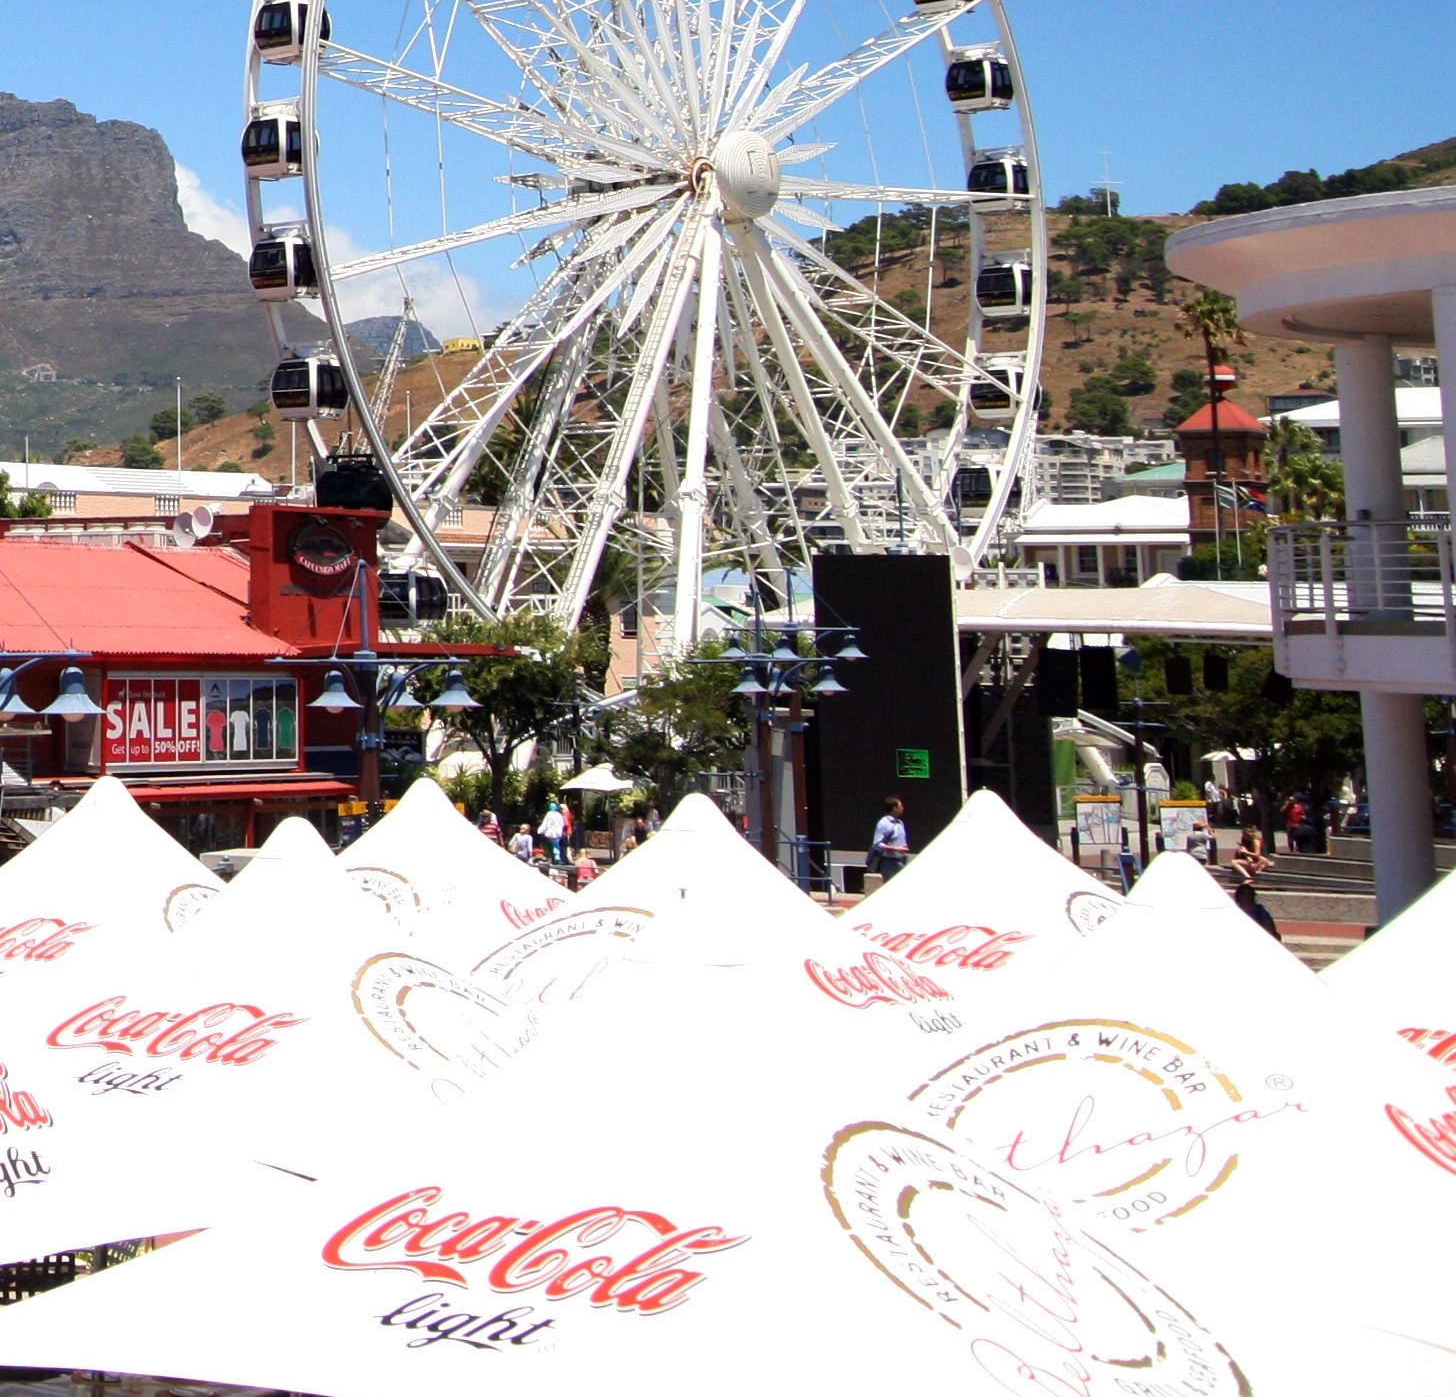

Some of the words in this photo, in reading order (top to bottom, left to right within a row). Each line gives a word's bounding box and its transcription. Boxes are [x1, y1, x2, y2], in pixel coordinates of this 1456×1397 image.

[106, 701, 197, 739] SALE
[111, 743, 125, 755] Get
[130, 745, 140, 757] up
[141, 744, 149, 754] to
[154, 740, 176, 754] 50%
[177, 740, 200, 753] OFF!
[852, 922, 1036, 971] ca-Cola
[804, 951, 955, 1010] Coca-Cola
[45, 995, 311, 1067] Coca-Cola
[75, 1061, 184, 1097] light
[1067, 1032, 1081, 1047] &
[1097, 1030, 1162, 1062] WINE
[1160, 1054, 1208, 1096] BAR
[880, 1144, 945, 1174] WINE
[994, 1094, 1314, 1178] thazar
[949, 1160, 1009, 1203] BAR
[321, 1185, 755, 1317] Coca-Cola
[851, 1165, 960, 1304] RESTAURANT
[373, 1292, 558, 1354] light
